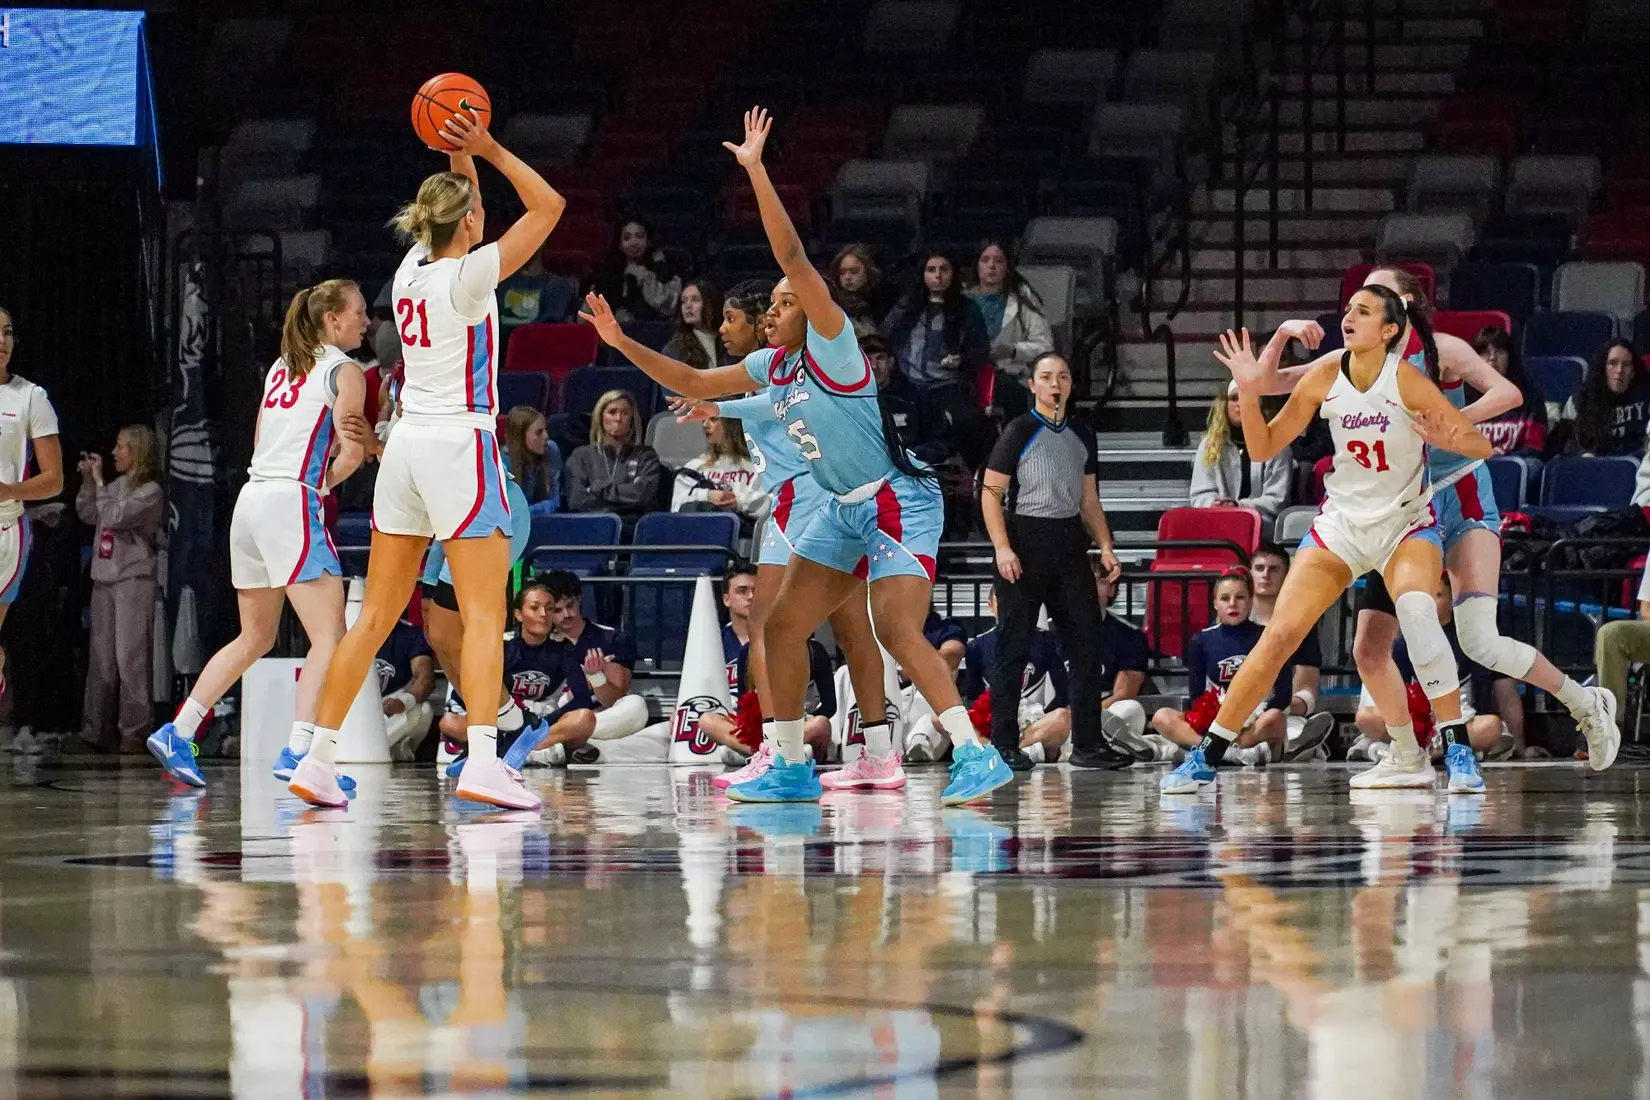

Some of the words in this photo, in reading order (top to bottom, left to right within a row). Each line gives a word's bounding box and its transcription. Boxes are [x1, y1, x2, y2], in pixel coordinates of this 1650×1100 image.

[397, 297, 432, 348] 21
[264, 367, 307, 409] 23
[787, 418, 822, 461] 5
[1341, 411, 1391, 434] Liberty
[1346, 439, 1390, 473] 31
[511, 675, 547, 700] LU
